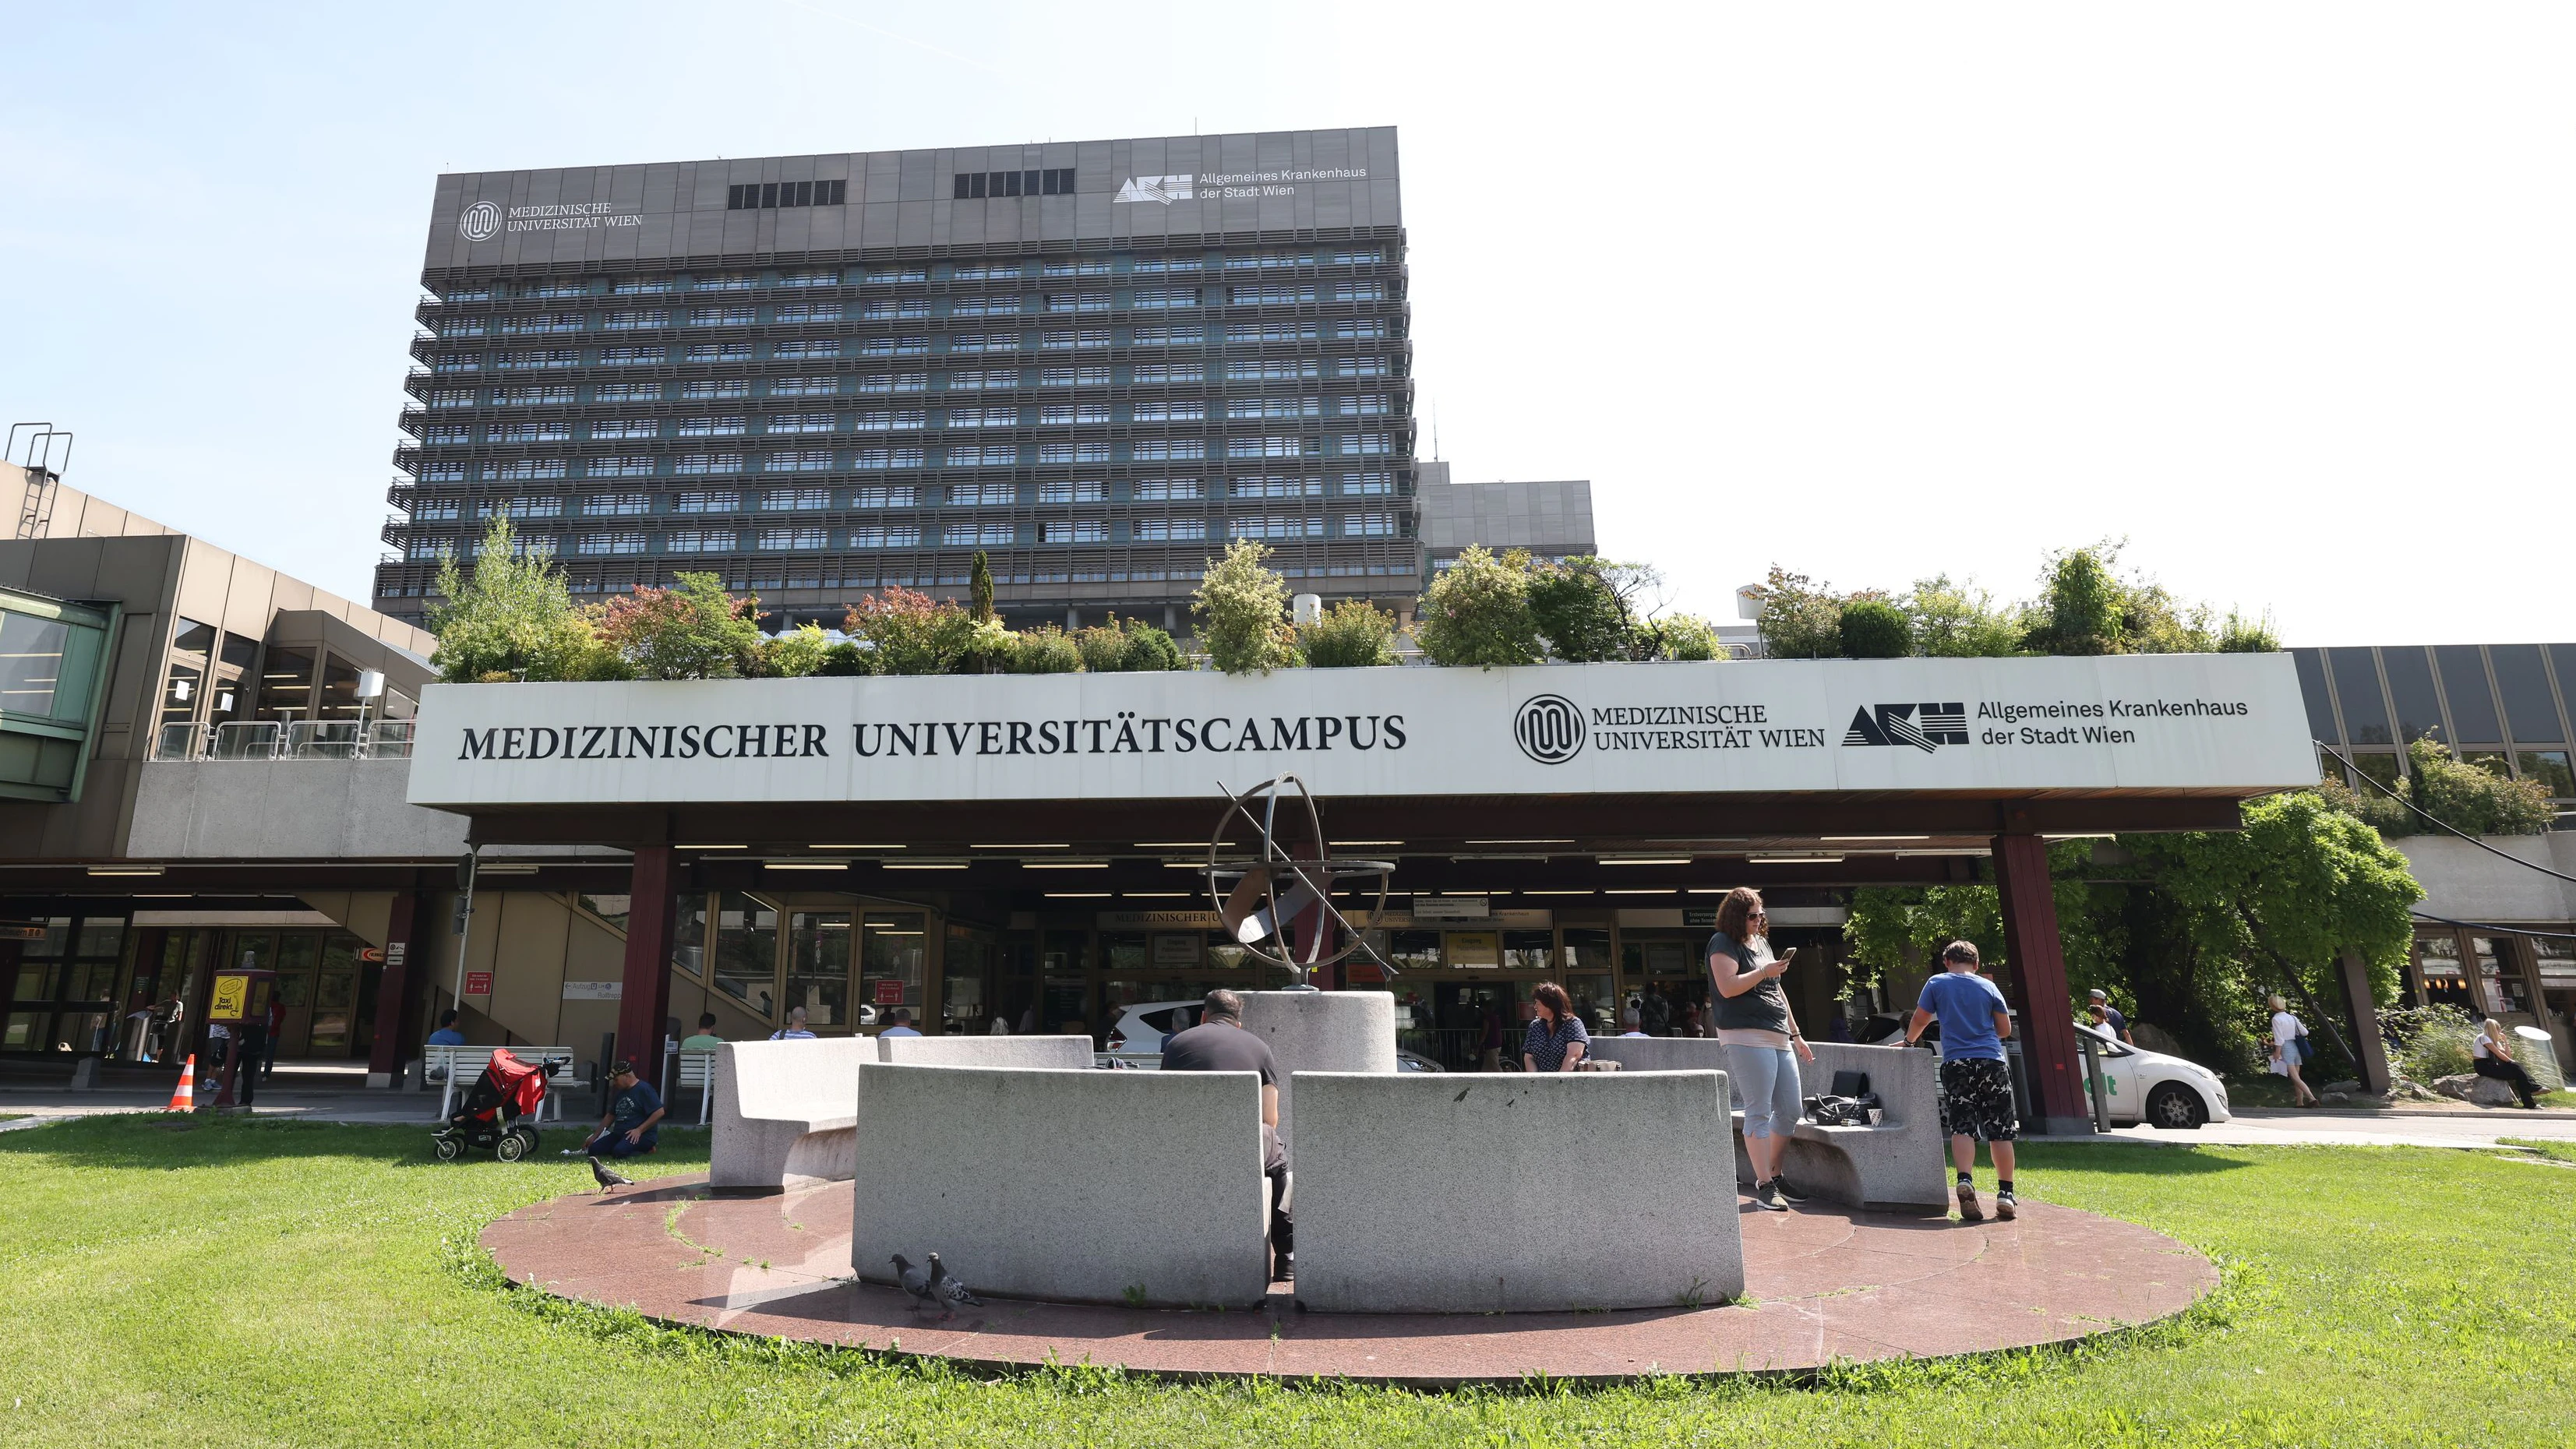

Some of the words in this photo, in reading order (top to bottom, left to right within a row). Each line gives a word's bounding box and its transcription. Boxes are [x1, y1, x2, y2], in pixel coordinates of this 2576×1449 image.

[1200, 171, 1278, 186] Allgemeines
[1281, 167, 1367, 182] Krankenhaus
[1200, 188, 1220, 199] der
[1224, 186, 1261, 199] Stadt
[1262, 185, 1294, 196] Wien
[508, 203, 612, 218] MEDIZINISCHE
[507, 214, 601, 232] UNIVERSITÄT
[604, 214, 644, 227] WIEN
[1591, 705, 1767, 726] MEDIZINISCHE
[1977, 700, 2104, 724] Allgemeines
[2108, 698, 2249, 717] Krankenhaus
[457, 724, 830, 760] MEDIZINISCHER
[852, 711, 1407, 757] UNIVERSITÄTSCAMPUS
[1593, 725, 1752, 751] UNIVERSITÄT
[1758, 728, 1825, 748] WIEN
[1981, 727, 2015, 745] der
[2020, 726, 2080, 745] Stadt
[2081, 725, 2136, 744] Wien
[1115, 912, 1207, 922] MEDIZINISCHER
